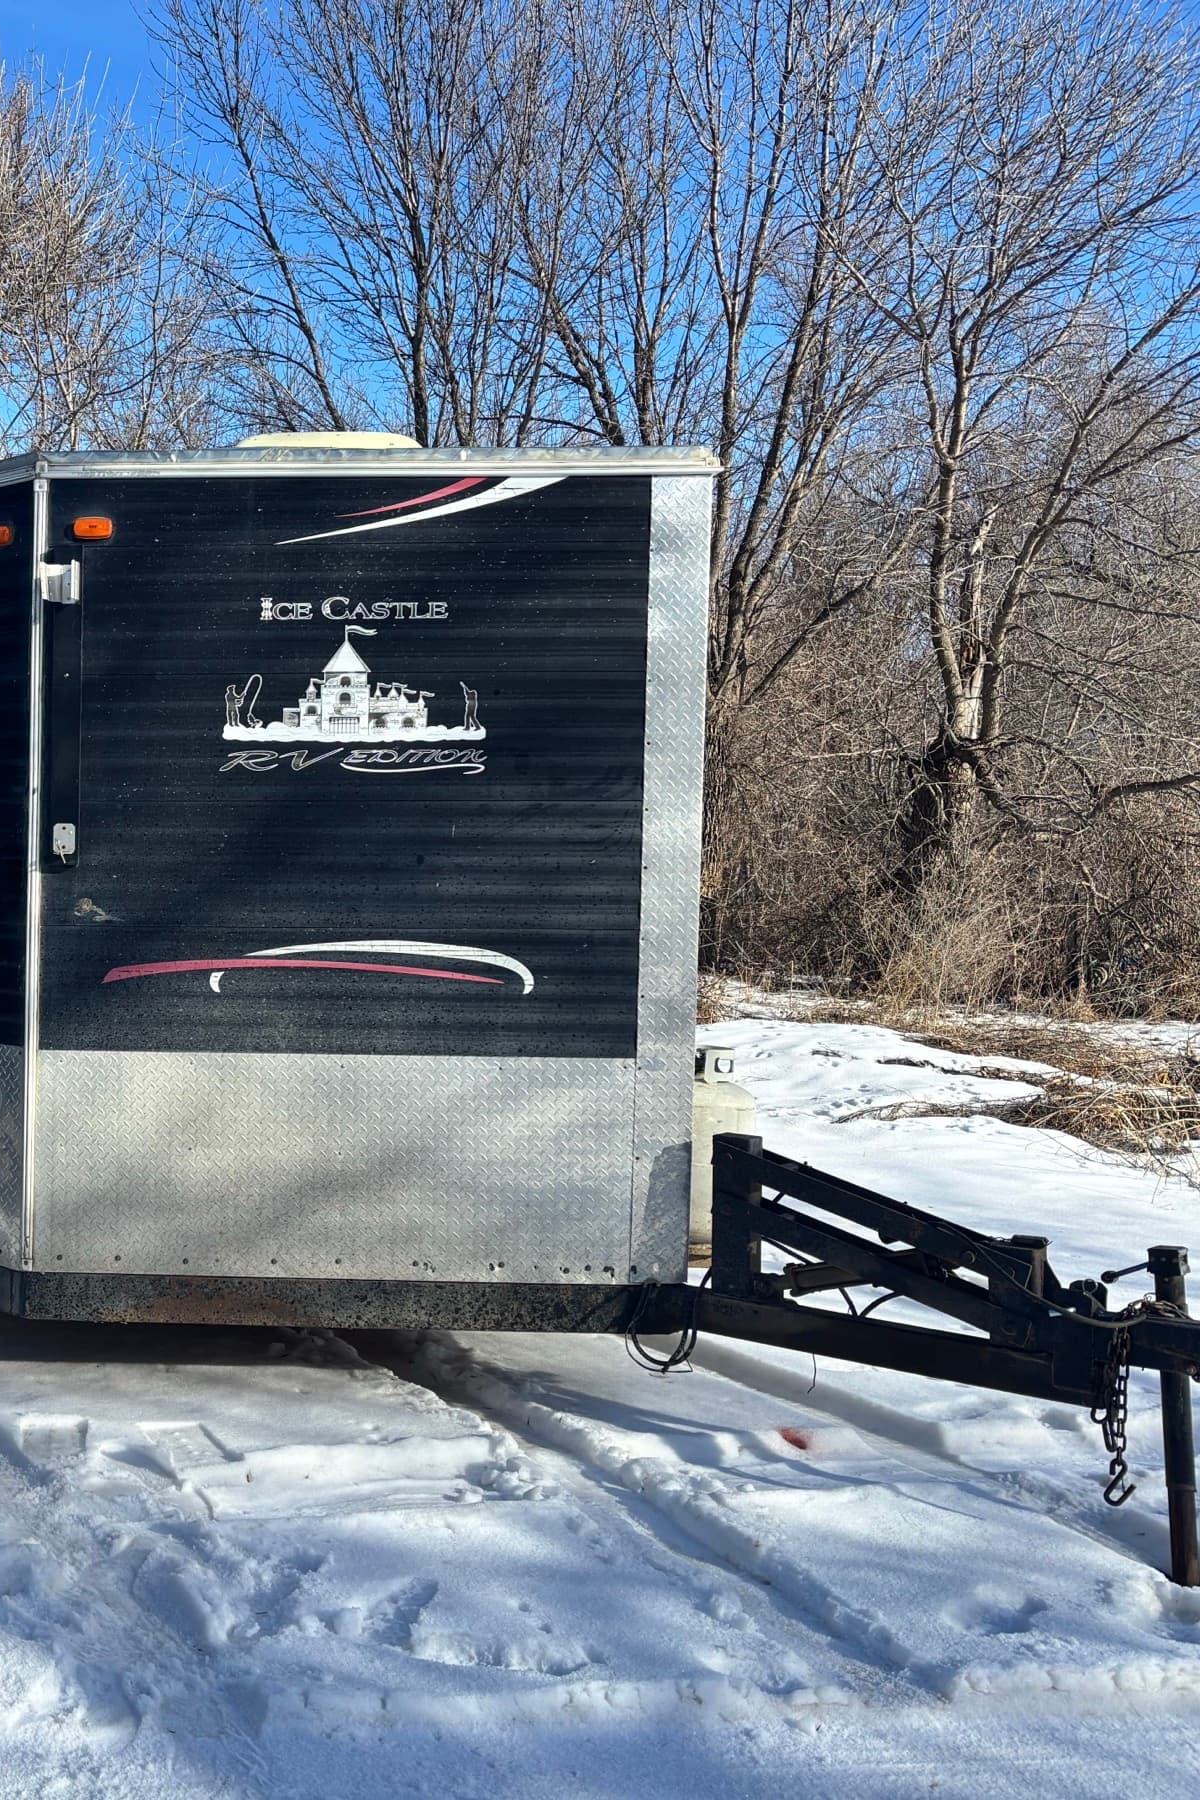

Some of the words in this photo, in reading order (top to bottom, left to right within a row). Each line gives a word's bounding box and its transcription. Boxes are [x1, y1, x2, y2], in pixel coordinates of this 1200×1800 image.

[260, 597, 313, 620] ICE
[321, 596, 449, 620] CASTLE
[219, 747, 344, 772] RV
[341, 748, 488, 766] EDITION
